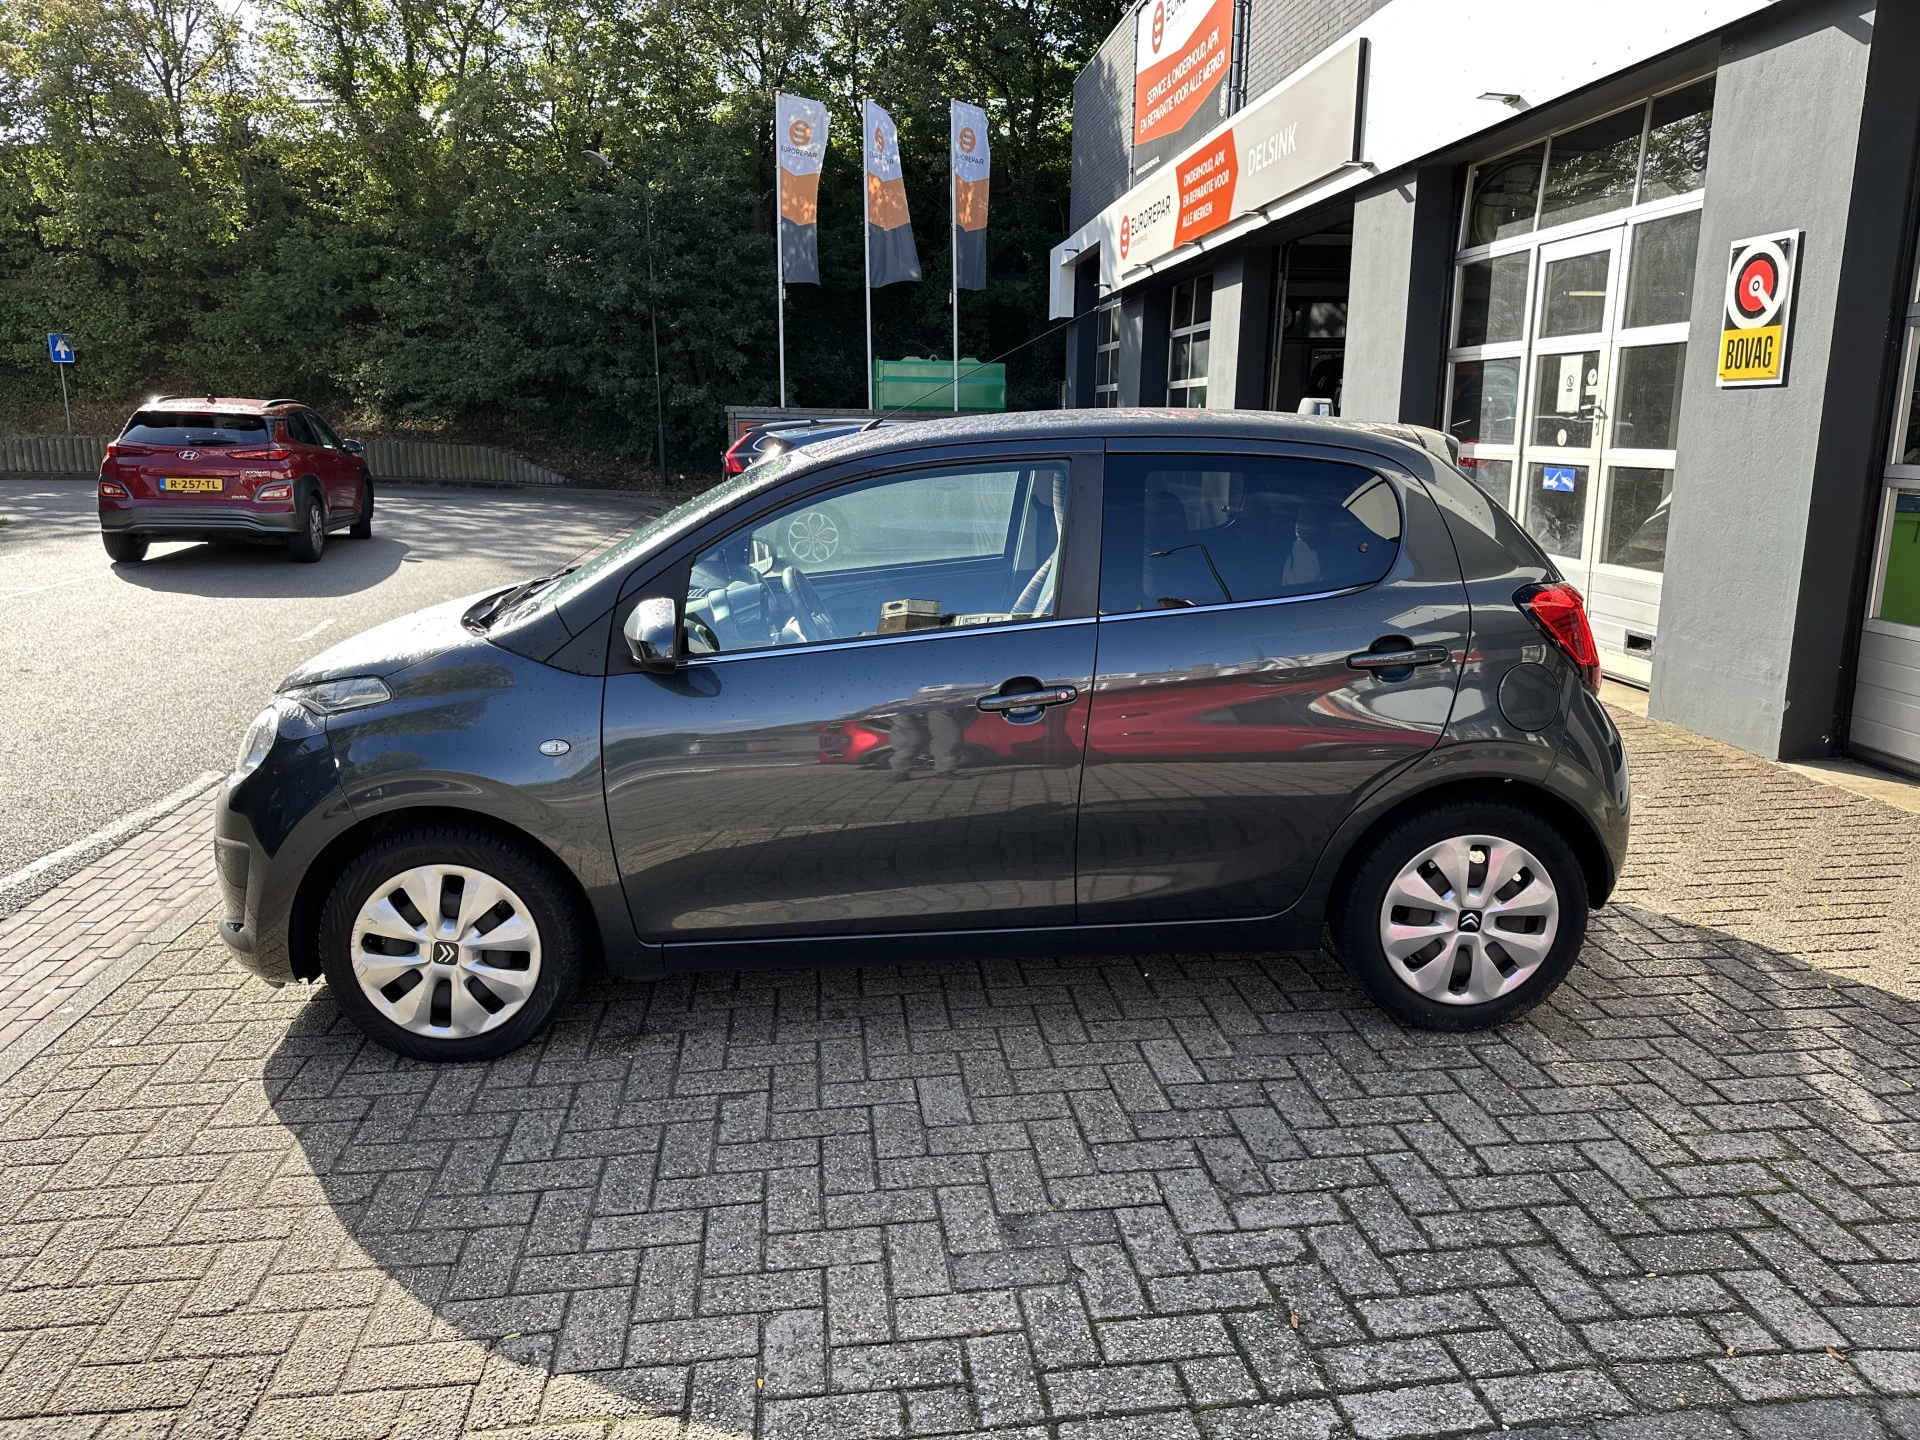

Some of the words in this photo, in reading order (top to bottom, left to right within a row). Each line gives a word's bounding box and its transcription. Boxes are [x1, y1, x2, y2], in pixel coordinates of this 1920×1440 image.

[1147, 77, 1167, 106] SERVICE
[1167, 73, 1172, 89] &
[1172, 41, 1207, 84] ONDERHOUD,
[1207, 26, 1219, 53] APK
[1140, 117, 1148, 134] EN
[1148, 94, 1174, 128] REPARATIE
[1174, 82, 1189, 107] VOOR
[1189, 69, 1203, 95] ALLE
[1203, 47, 1226, 82] MERKEN
[780, 145, 817, 158] EUROREPAR
[1183, 157, 1214, 188] ONDERHOUD,
[1214, 148, 1226, 168] APK
[1248, 121, 1297, 176] DELSINK
[1182, 193, 1190, 209] EN
[1190, 178, 1214, 205] REPARATIE
[1214, 168, 1230, 190] VOOR
[1131, 195, 1171, 237] EUROREPAR
[1182, 211, 1193, 229] ALLE
[1193, 200, 1213, 223] MERKEN
[1725, 335, 1774, 370] BOVAG
[170, 480, 218, 489] R-257-TL
